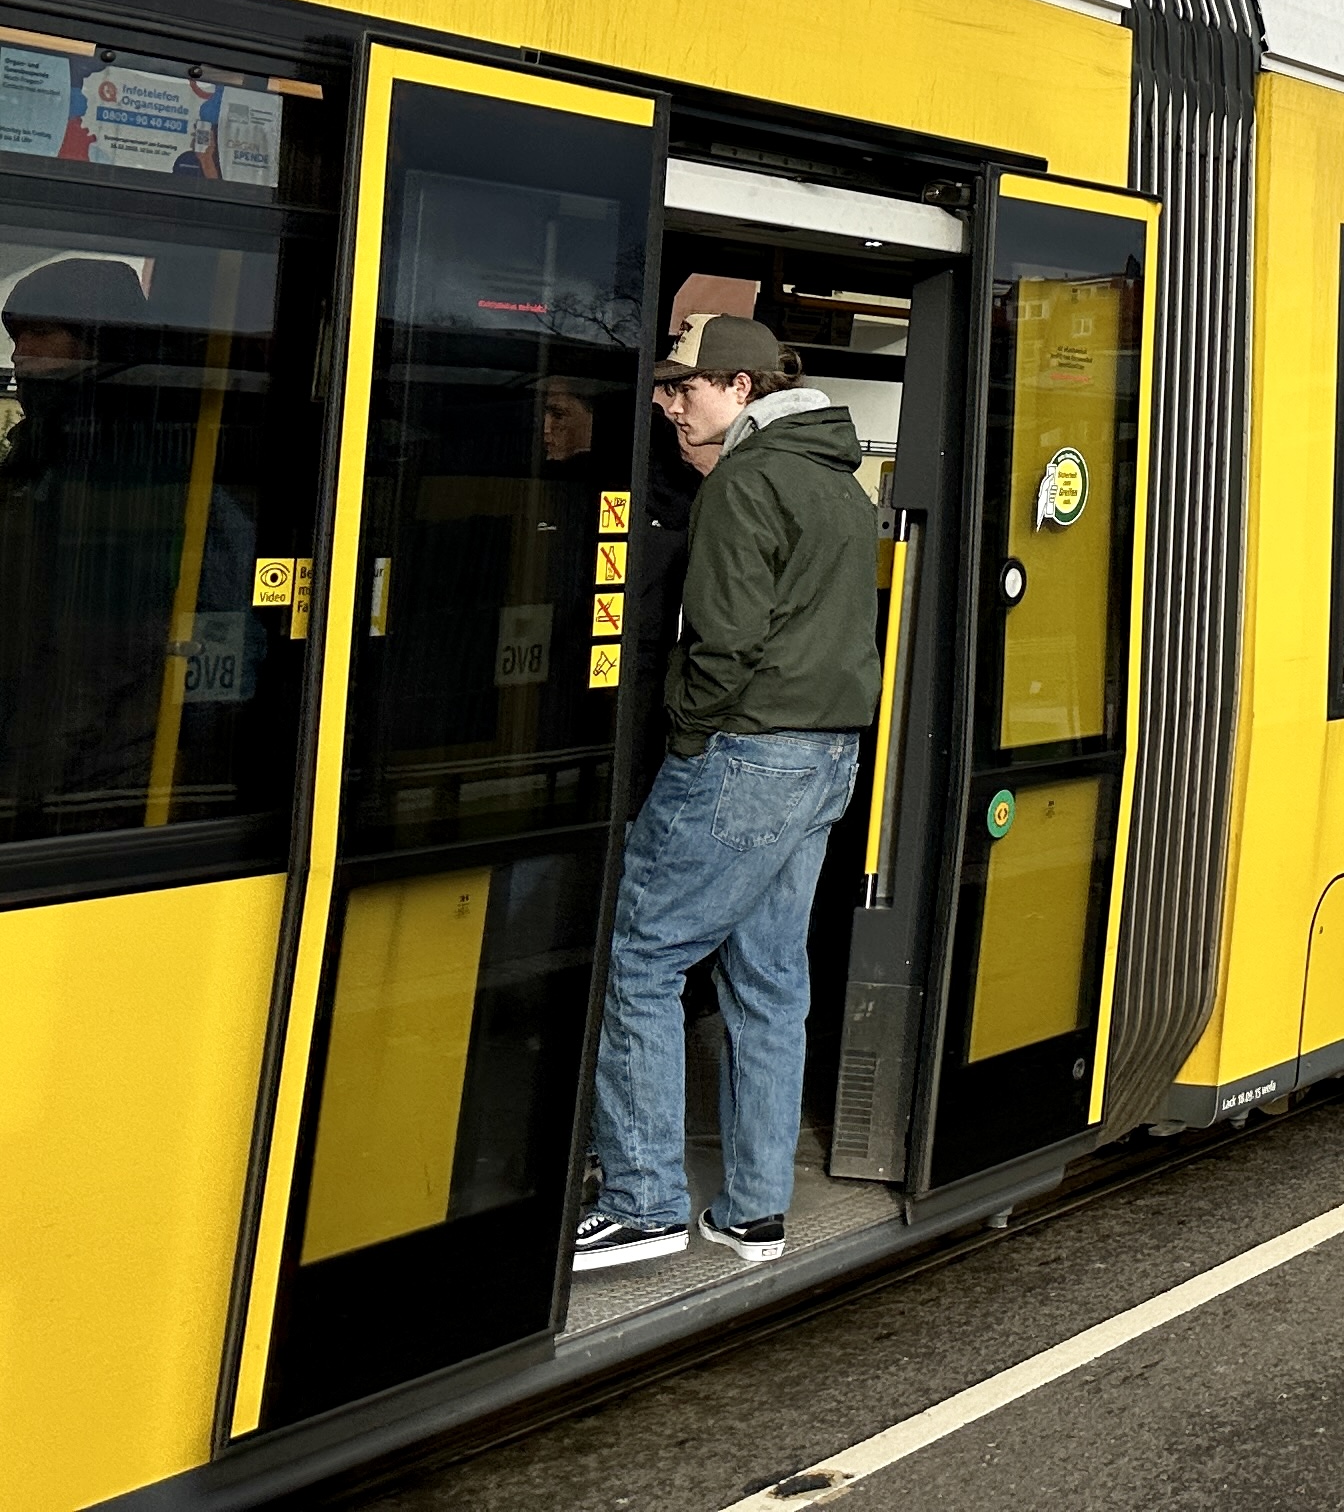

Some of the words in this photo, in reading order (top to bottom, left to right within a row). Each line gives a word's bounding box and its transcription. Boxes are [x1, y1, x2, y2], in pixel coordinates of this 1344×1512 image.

[122, 84, 179, 102] Infotelefon
[121, 96, 189, 115] Organspende
[102, 110, 128, 122] 0800
[136, 115, 148, 125] 90
[150, 117, 162, 127] 40
[163, 119, 182, 130] 400
[259, 592, 287, 603] Video
